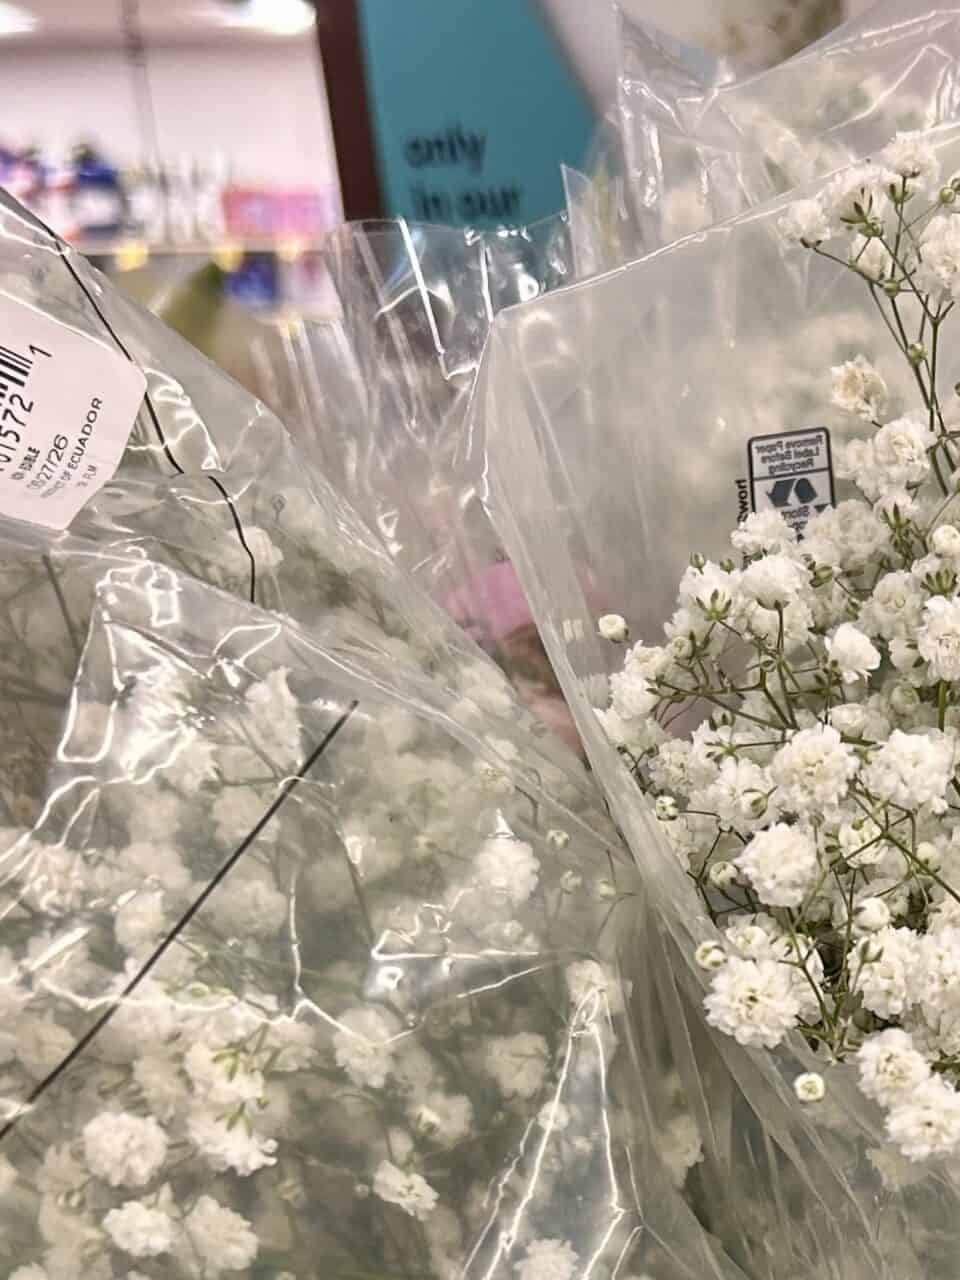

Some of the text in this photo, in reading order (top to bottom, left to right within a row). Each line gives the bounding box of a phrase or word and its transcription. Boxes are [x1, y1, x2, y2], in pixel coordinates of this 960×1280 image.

[405, 124, 486, 174] only
[411, 183, 448, 222] in
[67, 397, 103, 470] ECUADOR
